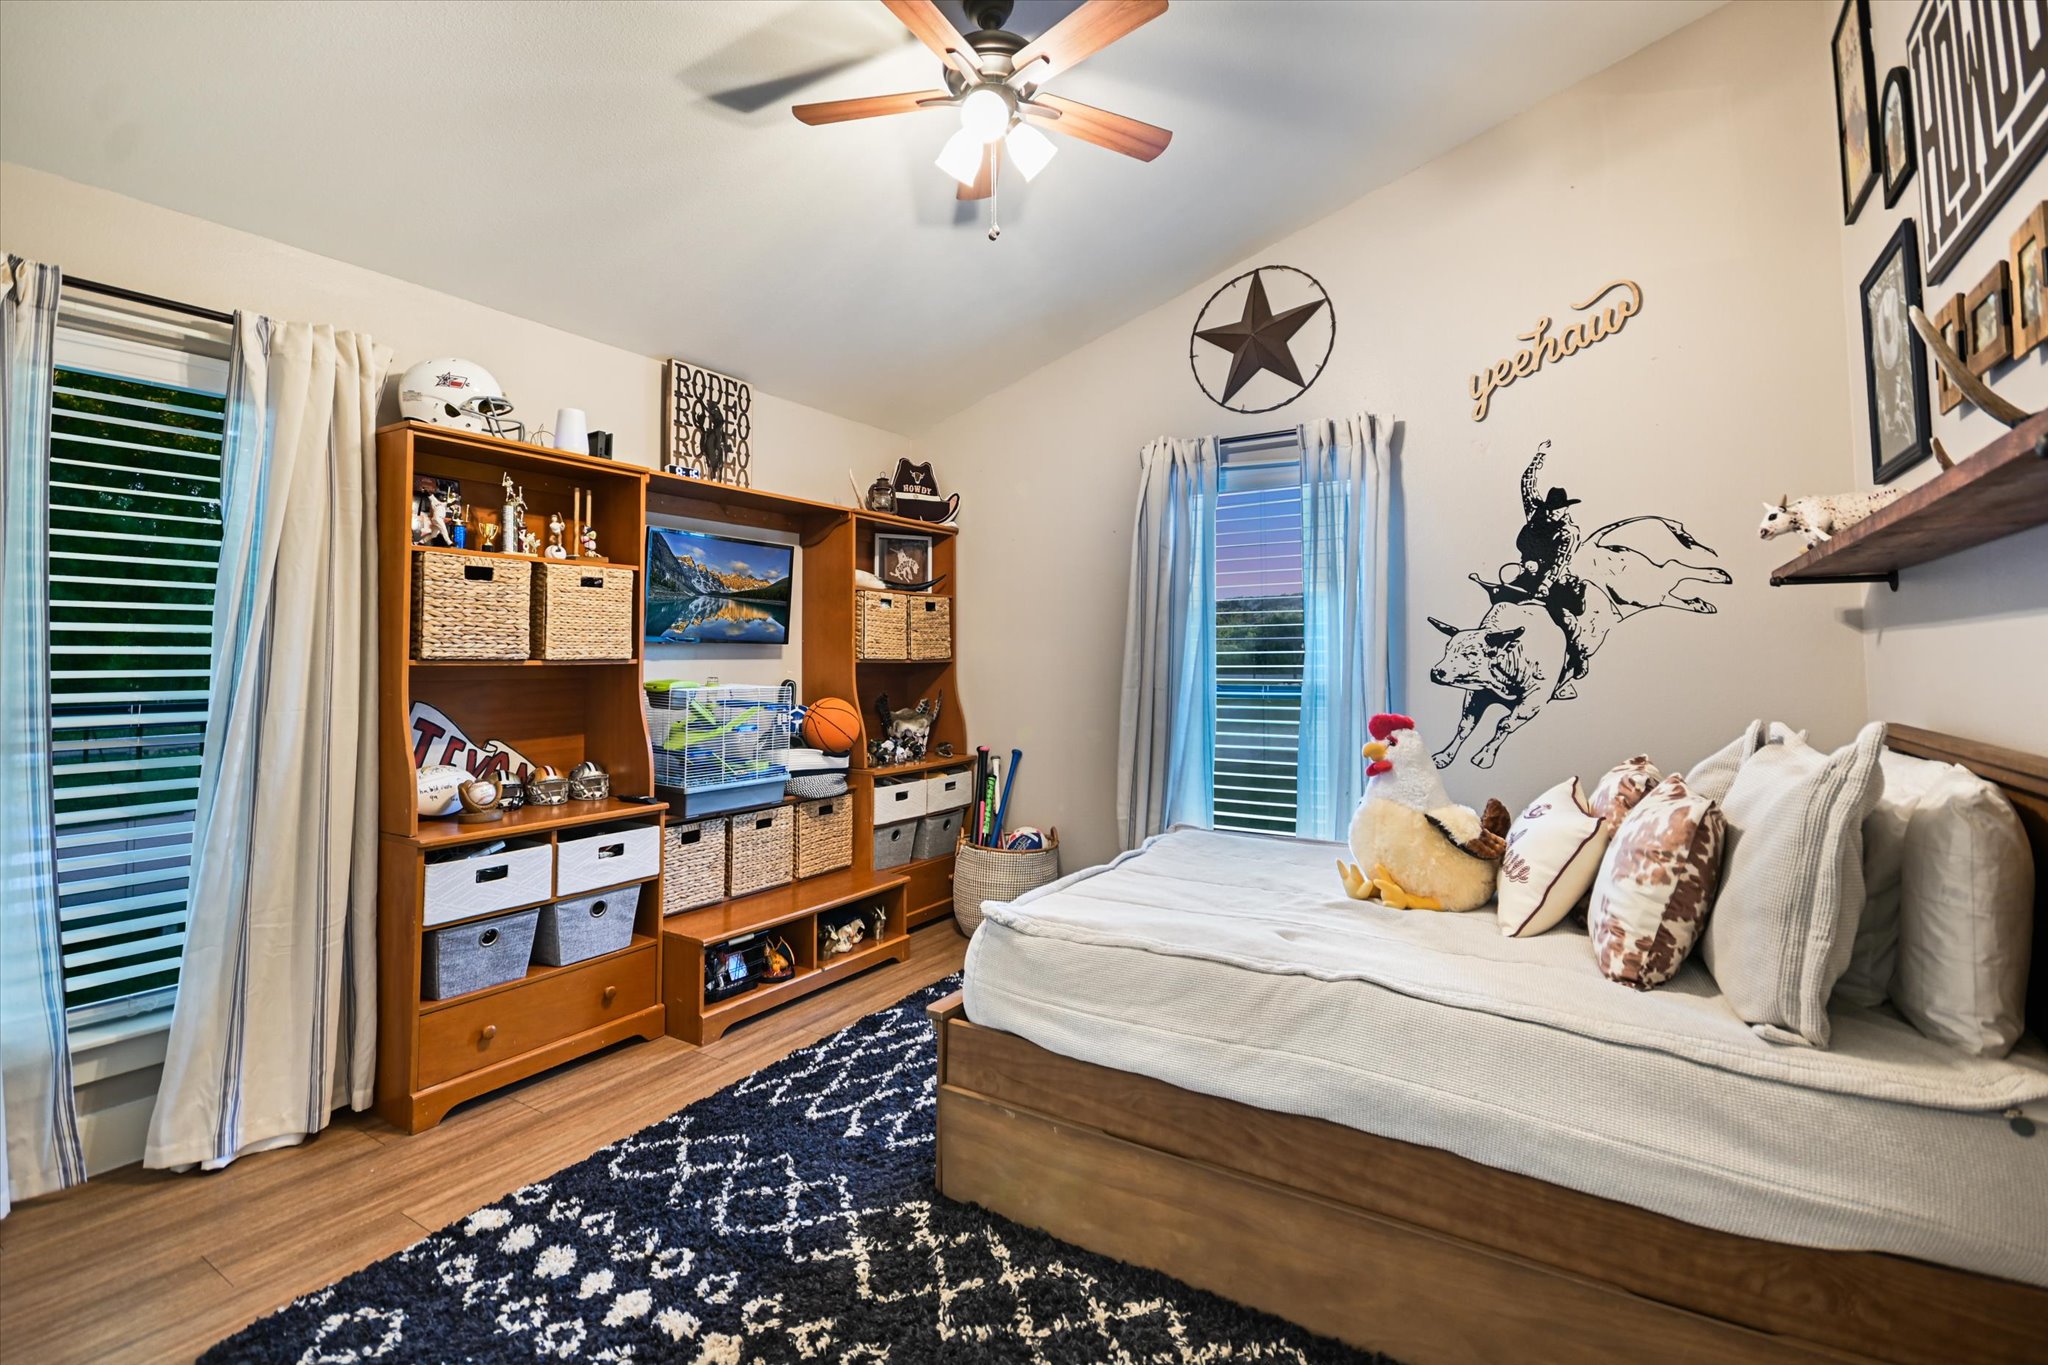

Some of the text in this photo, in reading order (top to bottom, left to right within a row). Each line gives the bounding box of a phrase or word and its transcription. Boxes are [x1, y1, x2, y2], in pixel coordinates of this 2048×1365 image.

[1468, 278, 1643, 422] yeehaw
[674, 362, 751, 413] RODEO
[673, 420, 750, 470] ROEO
[903, 484, 932, 495] HOWDY
